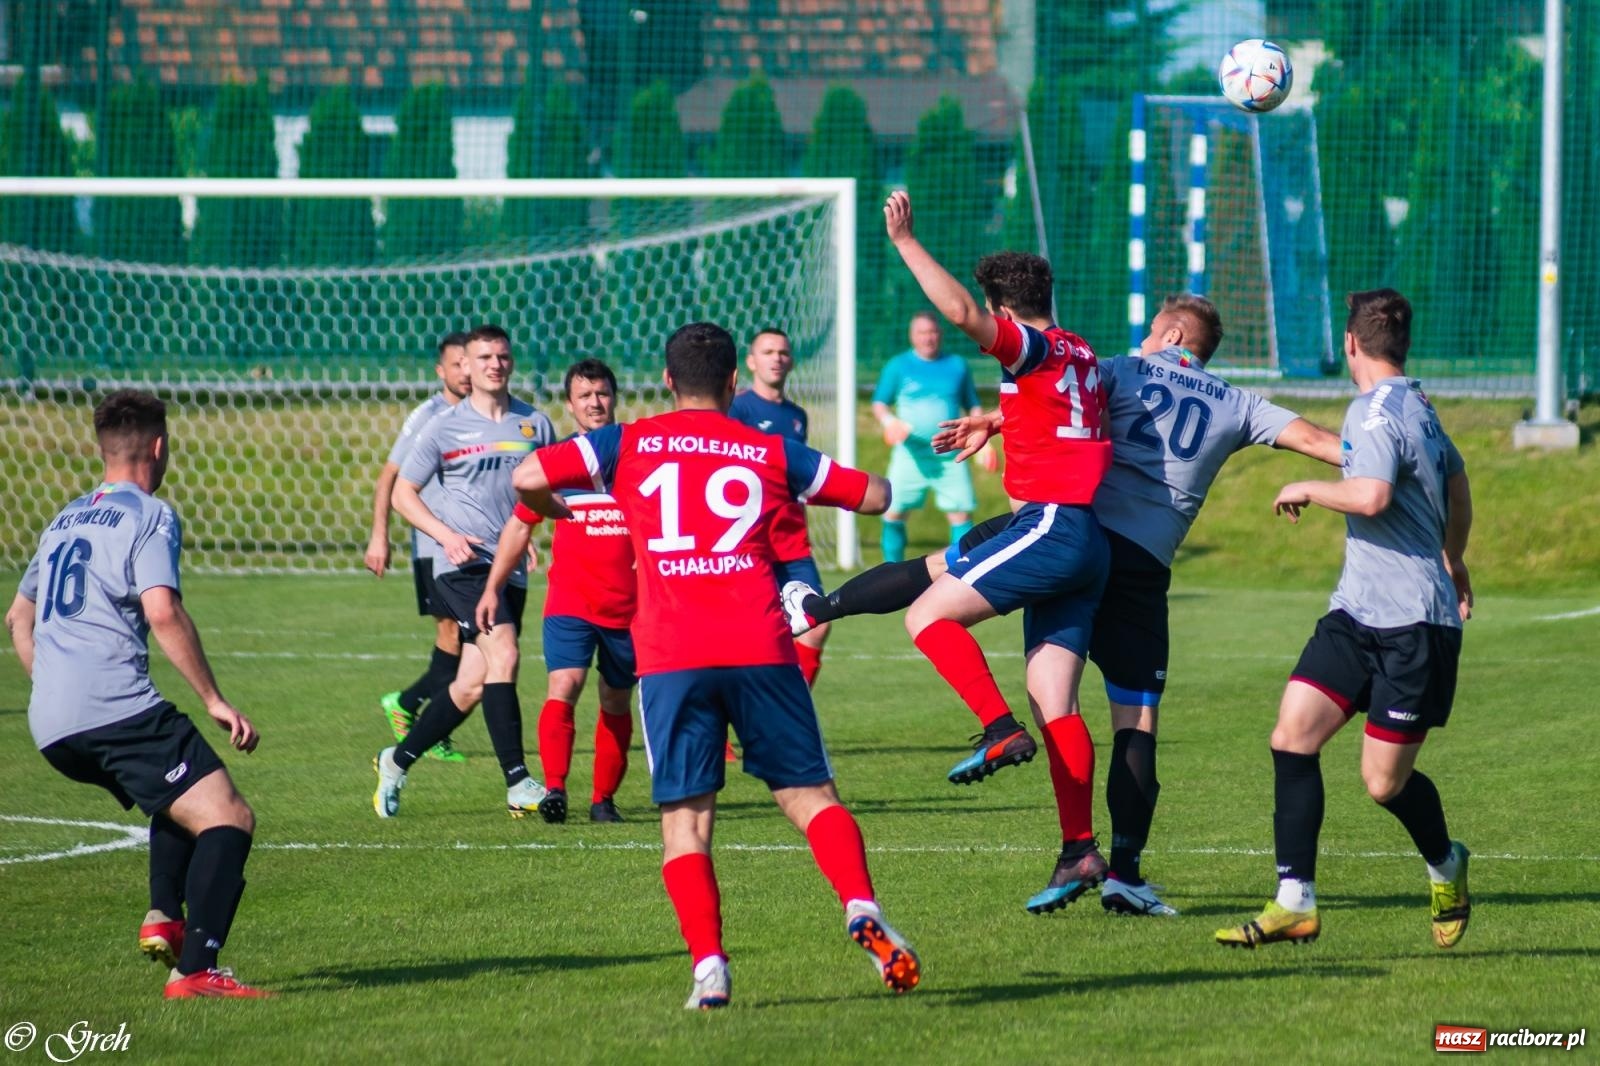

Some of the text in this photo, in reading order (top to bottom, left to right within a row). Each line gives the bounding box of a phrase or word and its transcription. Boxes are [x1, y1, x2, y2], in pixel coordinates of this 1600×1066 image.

[1137, 360, 1227, 401] LKS PAWŁÓW
[637, 436, 768, 464] KS KOLEJARZ
[1127, 382, 1214, 460] 20
[638, 462, 763, 552] 19
[42, 537, 92, 623] 16
[658, 554, 754, 577] CHAŁUPKI
